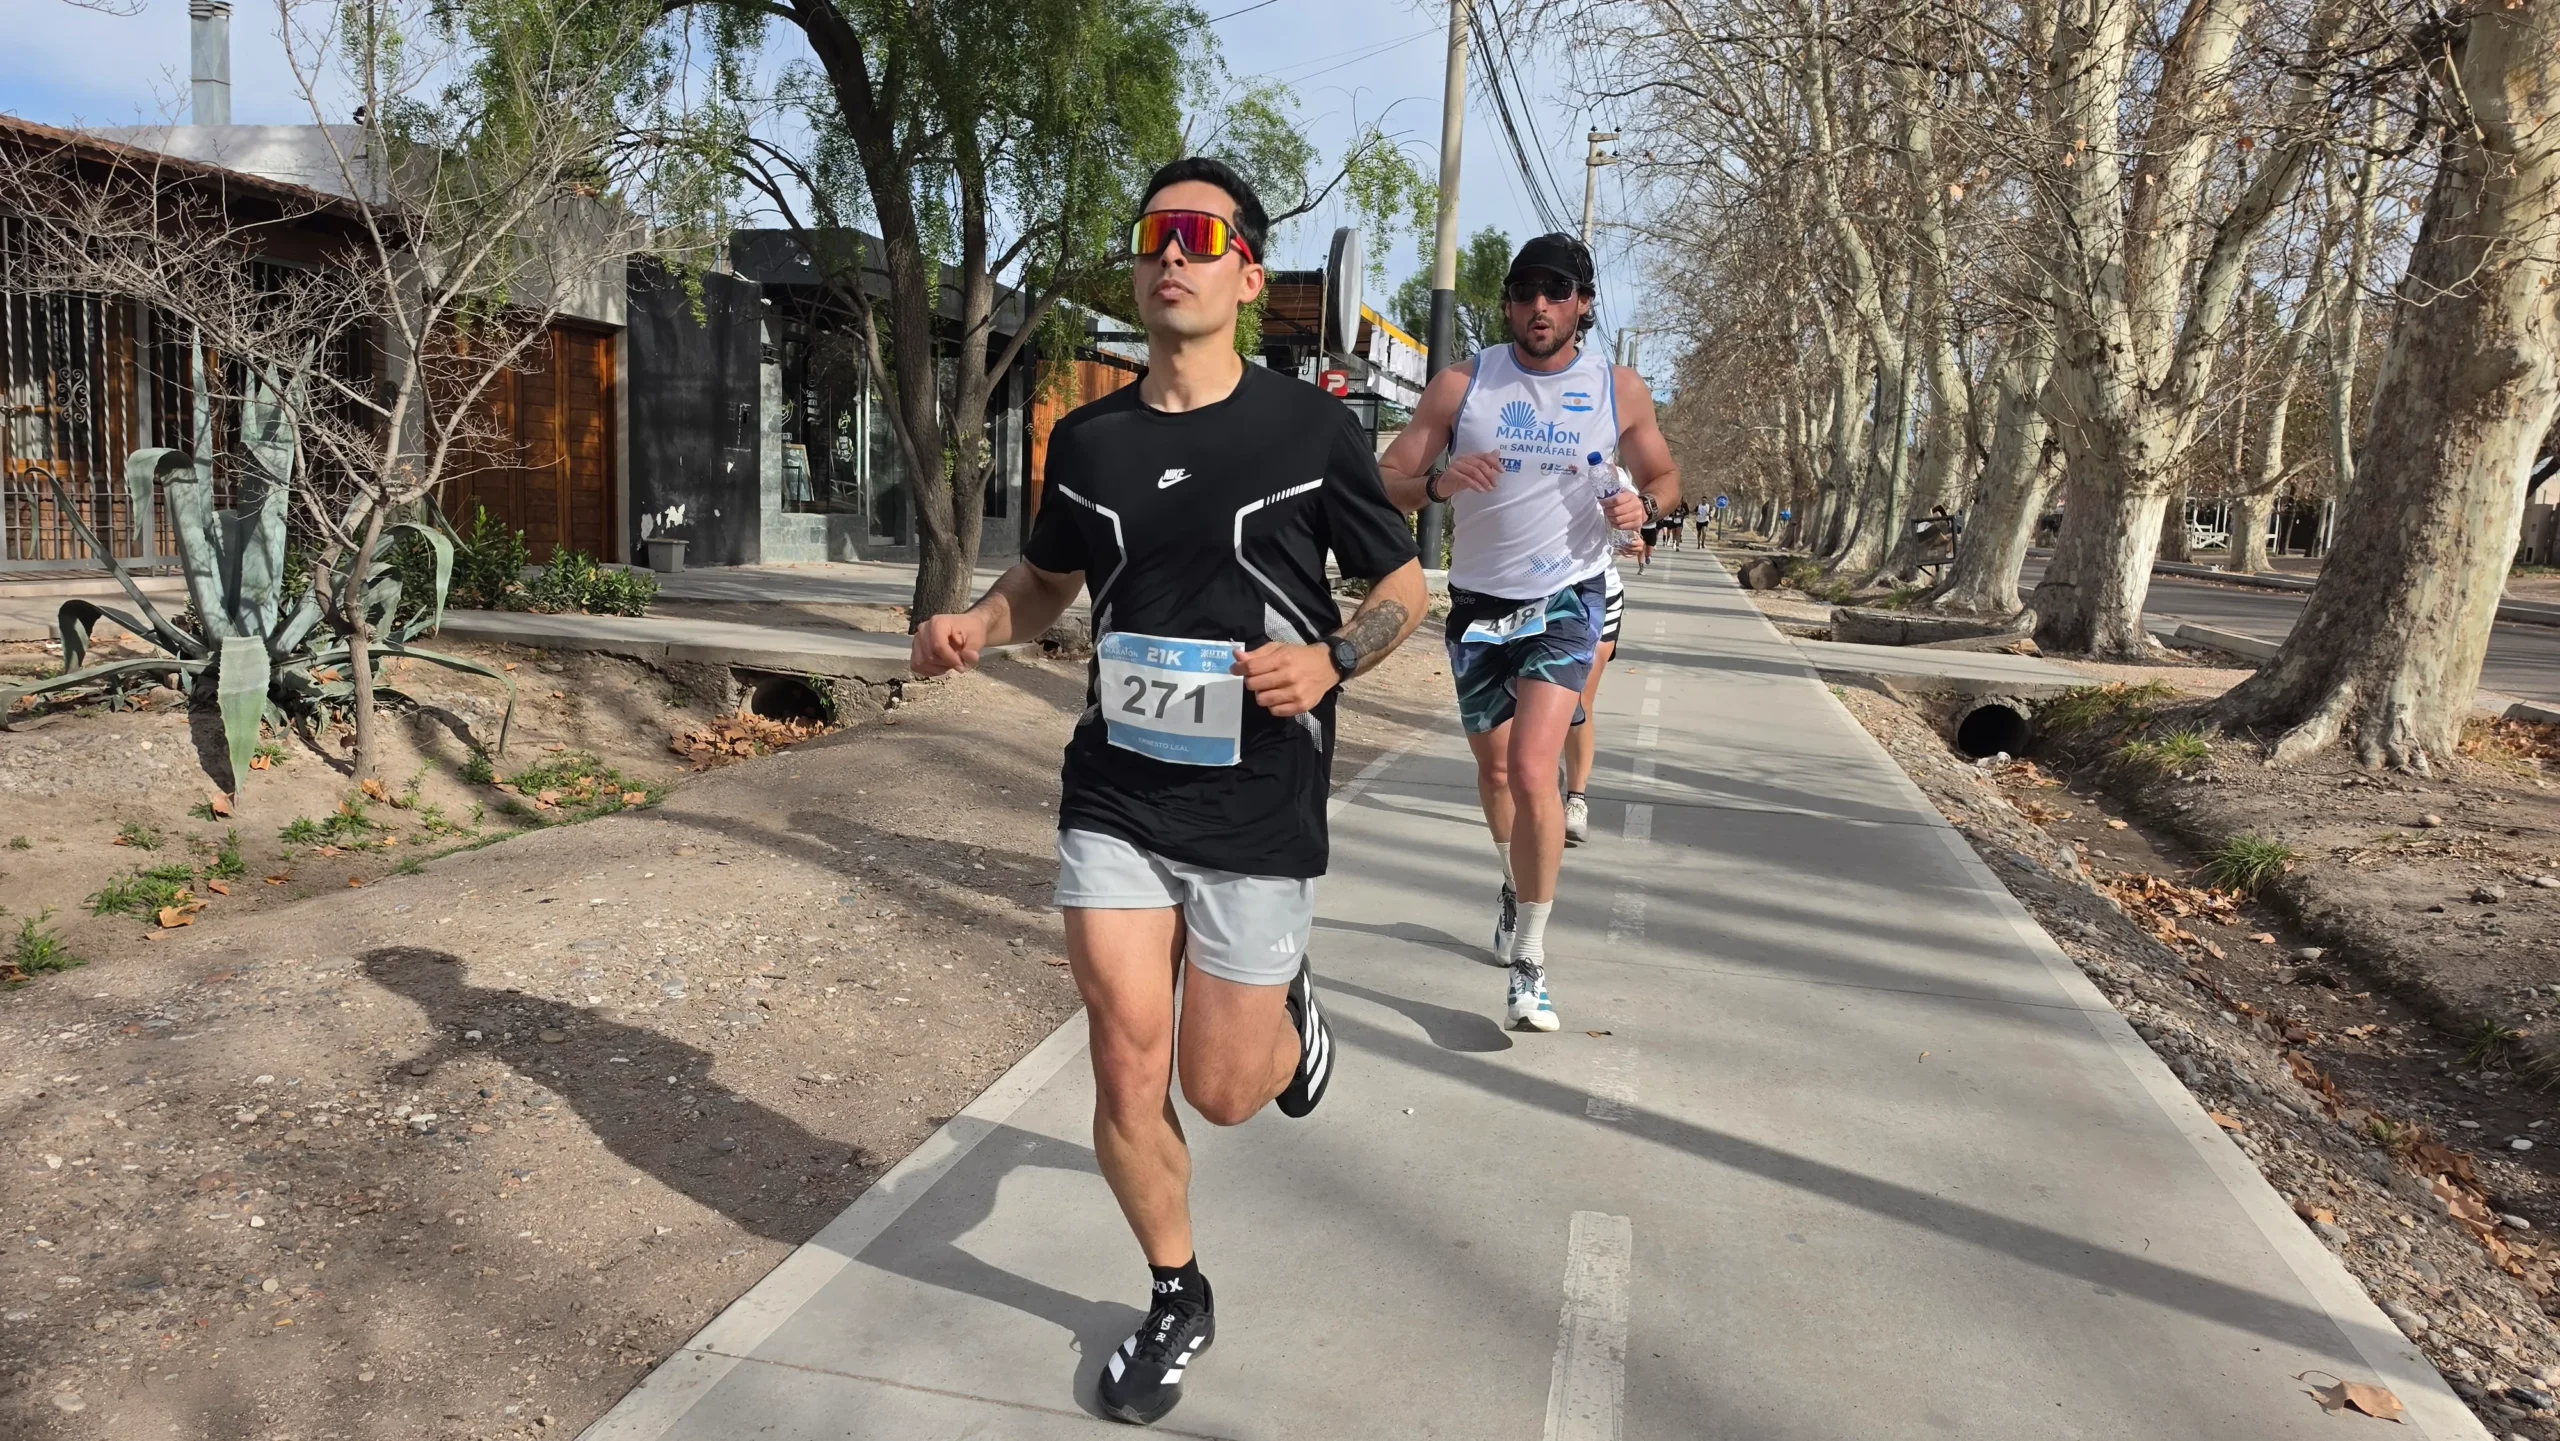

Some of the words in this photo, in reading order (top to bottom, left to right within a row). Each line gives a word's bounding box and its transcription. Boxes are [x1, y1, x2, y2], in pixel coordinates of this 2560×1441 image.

[1510, 443, 1534, 453] SAN
[1536, 445, 1578, 457] RAFAEL
[1163, 468, 1186, 480] NIKE
[1147, 646, 1185, 666] 21K
[1210, 649, 1228, 658] UTN
[1122, 675, 1206, 724] 271
[1170, 744, 1190, 752] LEAL
